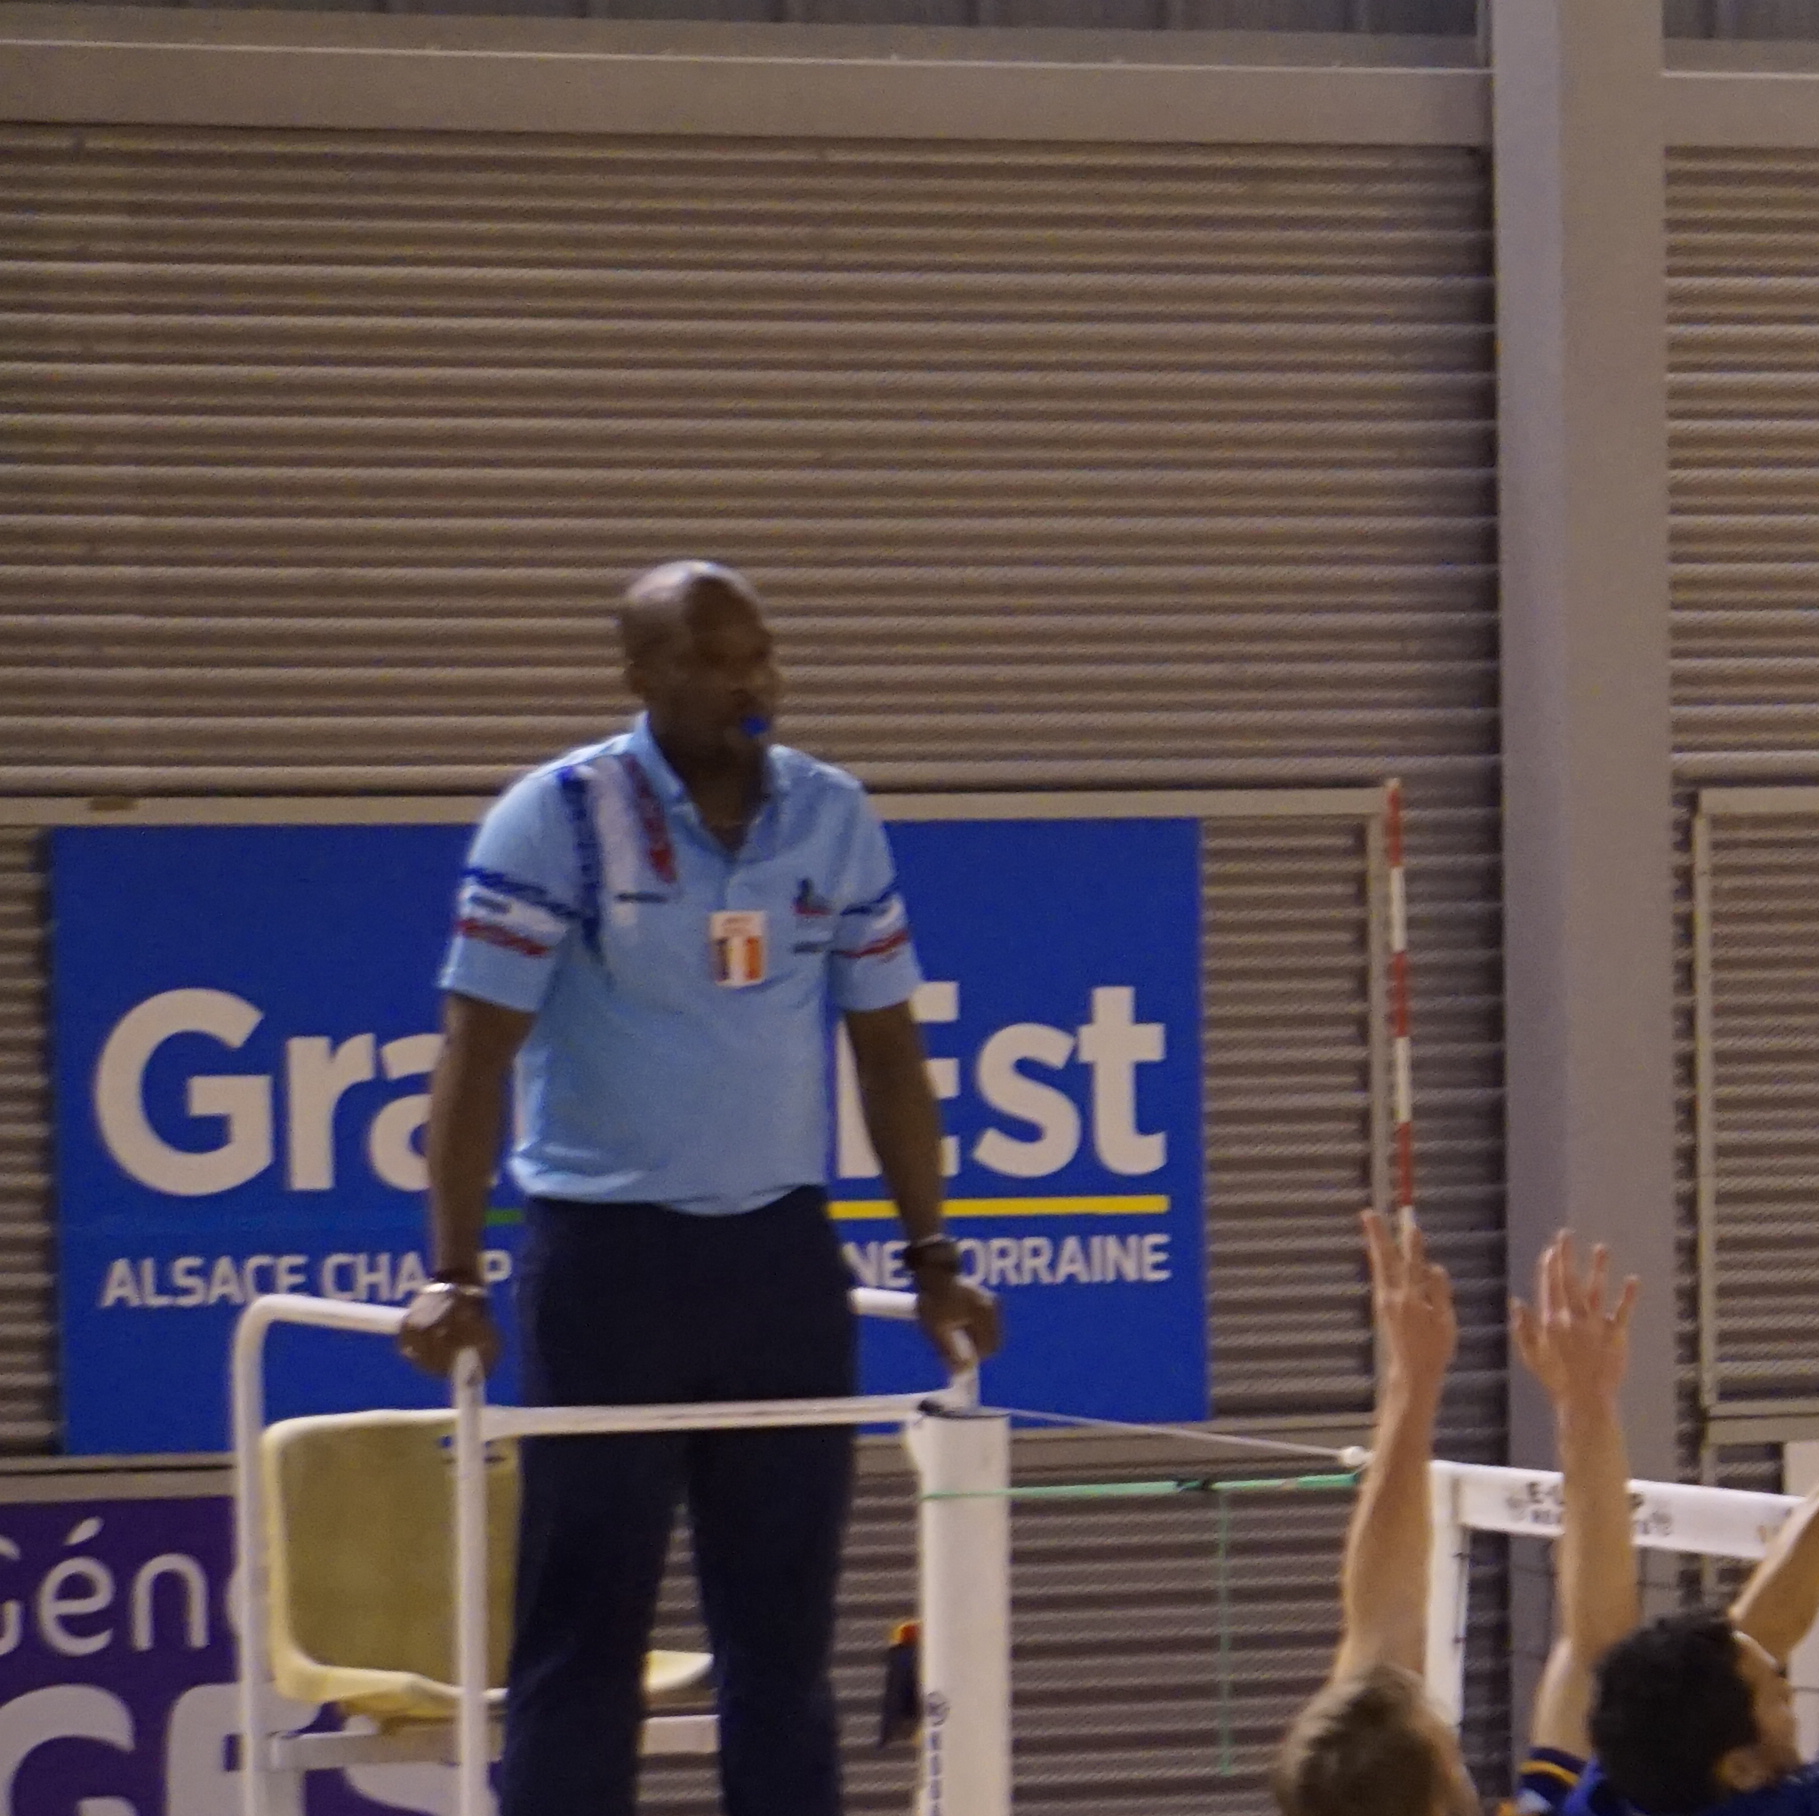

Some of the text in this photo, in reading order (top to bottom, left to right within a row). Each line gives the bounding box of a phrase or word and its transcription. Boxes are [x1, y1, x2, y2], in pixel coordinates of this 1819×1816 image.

[93, 988, 450, 1196] Gra
[101, 1253, 307, 1310] ALSACE
[958, 1234, 1172, 1292] ORRAINE
